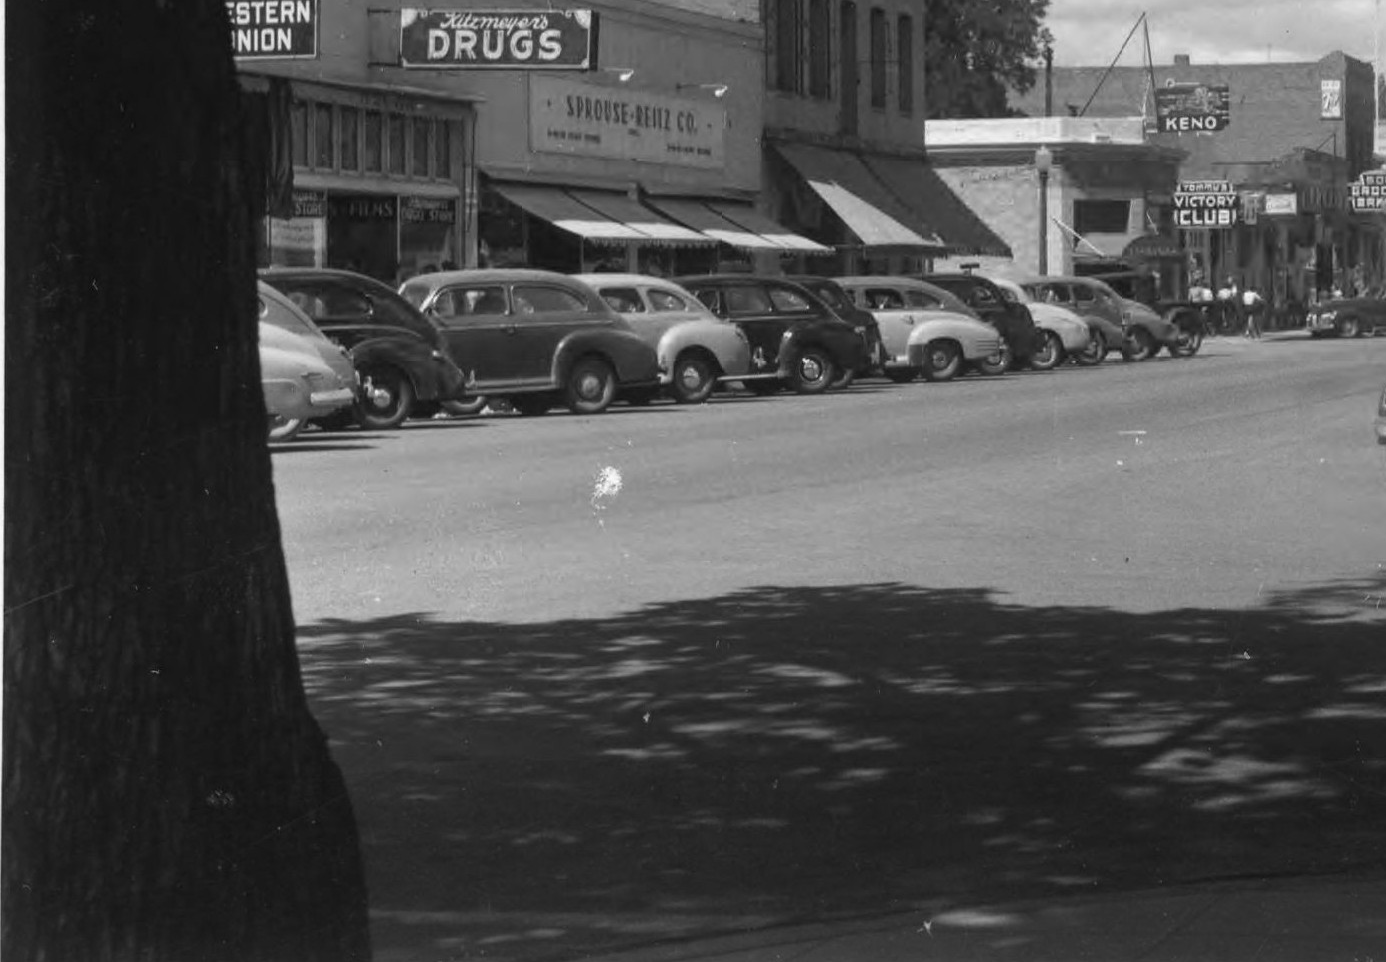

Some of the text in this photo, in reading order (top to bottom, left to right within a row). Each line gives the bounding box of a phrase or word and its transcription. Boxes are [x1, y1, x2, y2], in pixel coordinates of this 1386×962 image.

[226, 0, 311, 25] STERN
[440, 12, 548, 36] Kitzmeyer's
[231, 27, 292, 52] NION
[427, 28, 563, 60] DRUGS
[1165, 115, 1218, 131] KENO
[1174, 195, 1236, 208] VICTORY
[1179, 209, 1231, 226] CLUB
